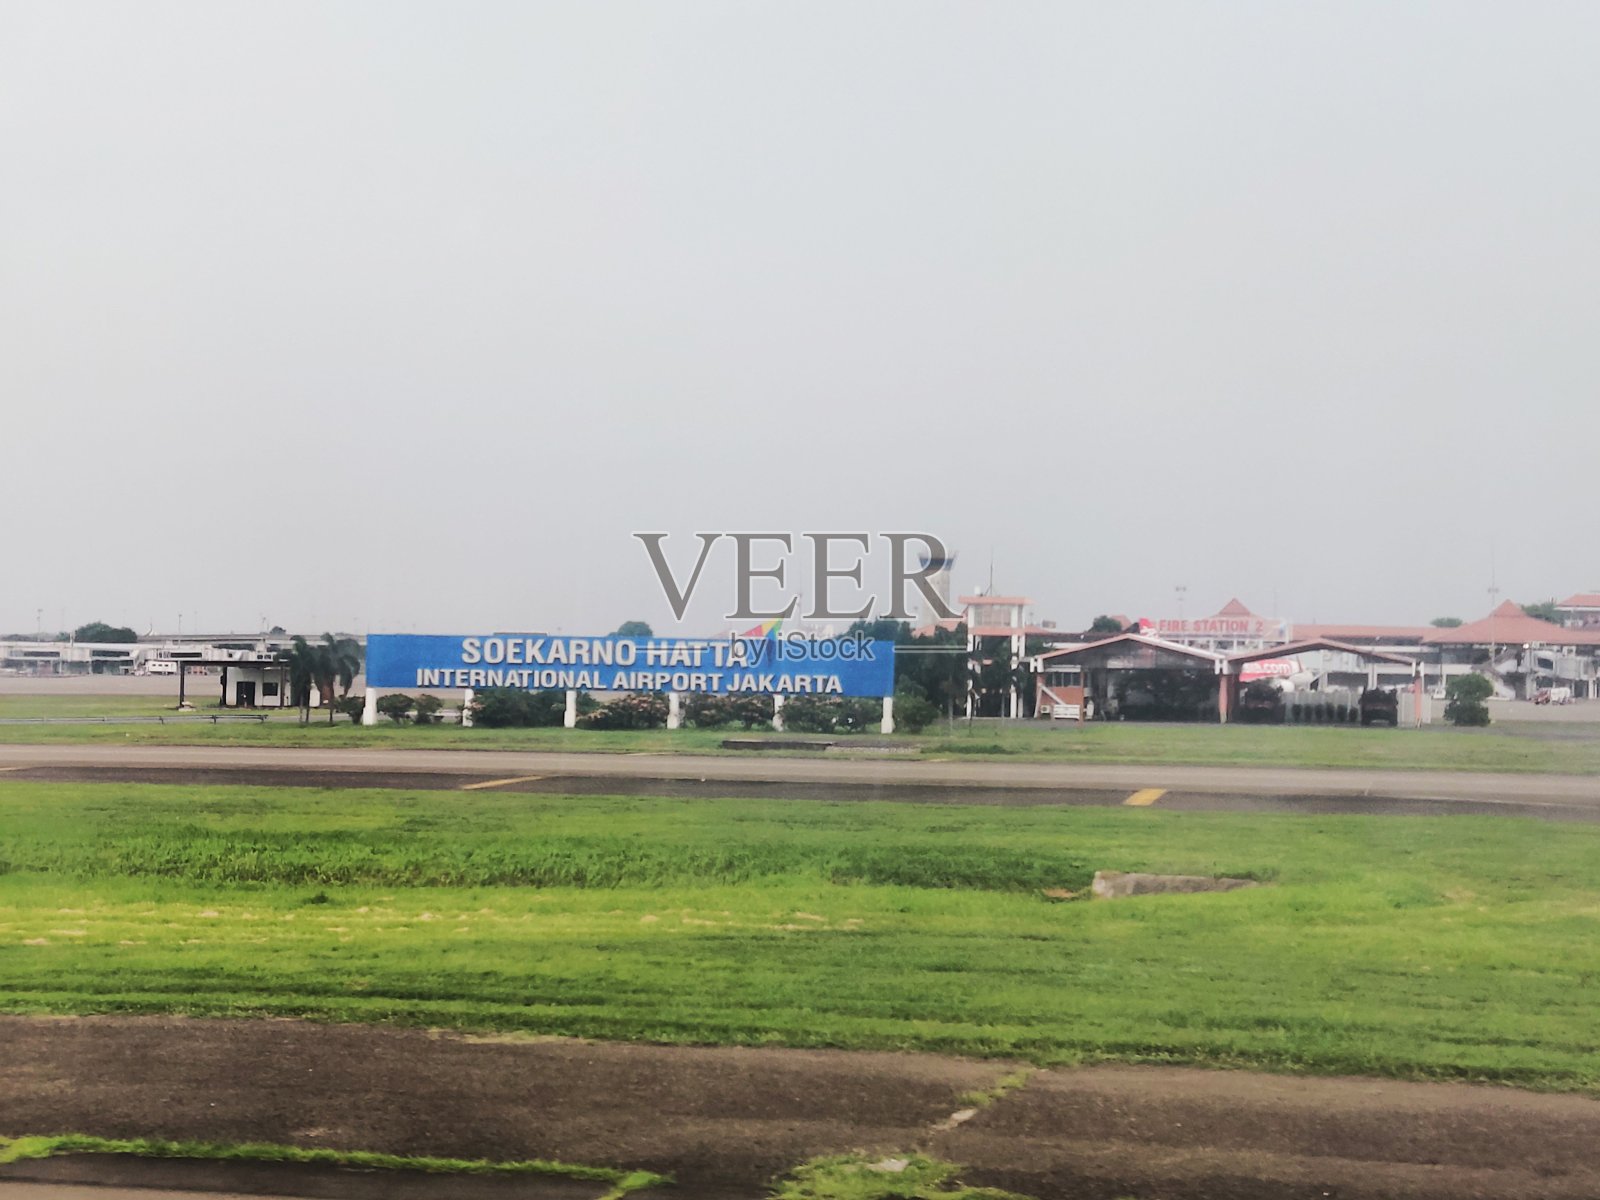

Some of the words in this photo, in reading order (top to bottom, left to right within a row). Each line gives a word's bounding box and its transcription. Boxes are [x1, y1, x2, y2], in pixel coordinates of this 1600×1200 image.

[1159, 619, 1189, 632] FIRE
[1193, 619, 1249, 632] STATION
[1255, 620, 1264, 632] 2
[461, 637, 637, 666] SOEKARNO
[646, 640, 748, 668] HATTA
[416, 668, 607, 688] INTERNATIONAL
[612, 671, 724, 692] AIRPORT
[726, 673, 843, 694] JAKARTA
